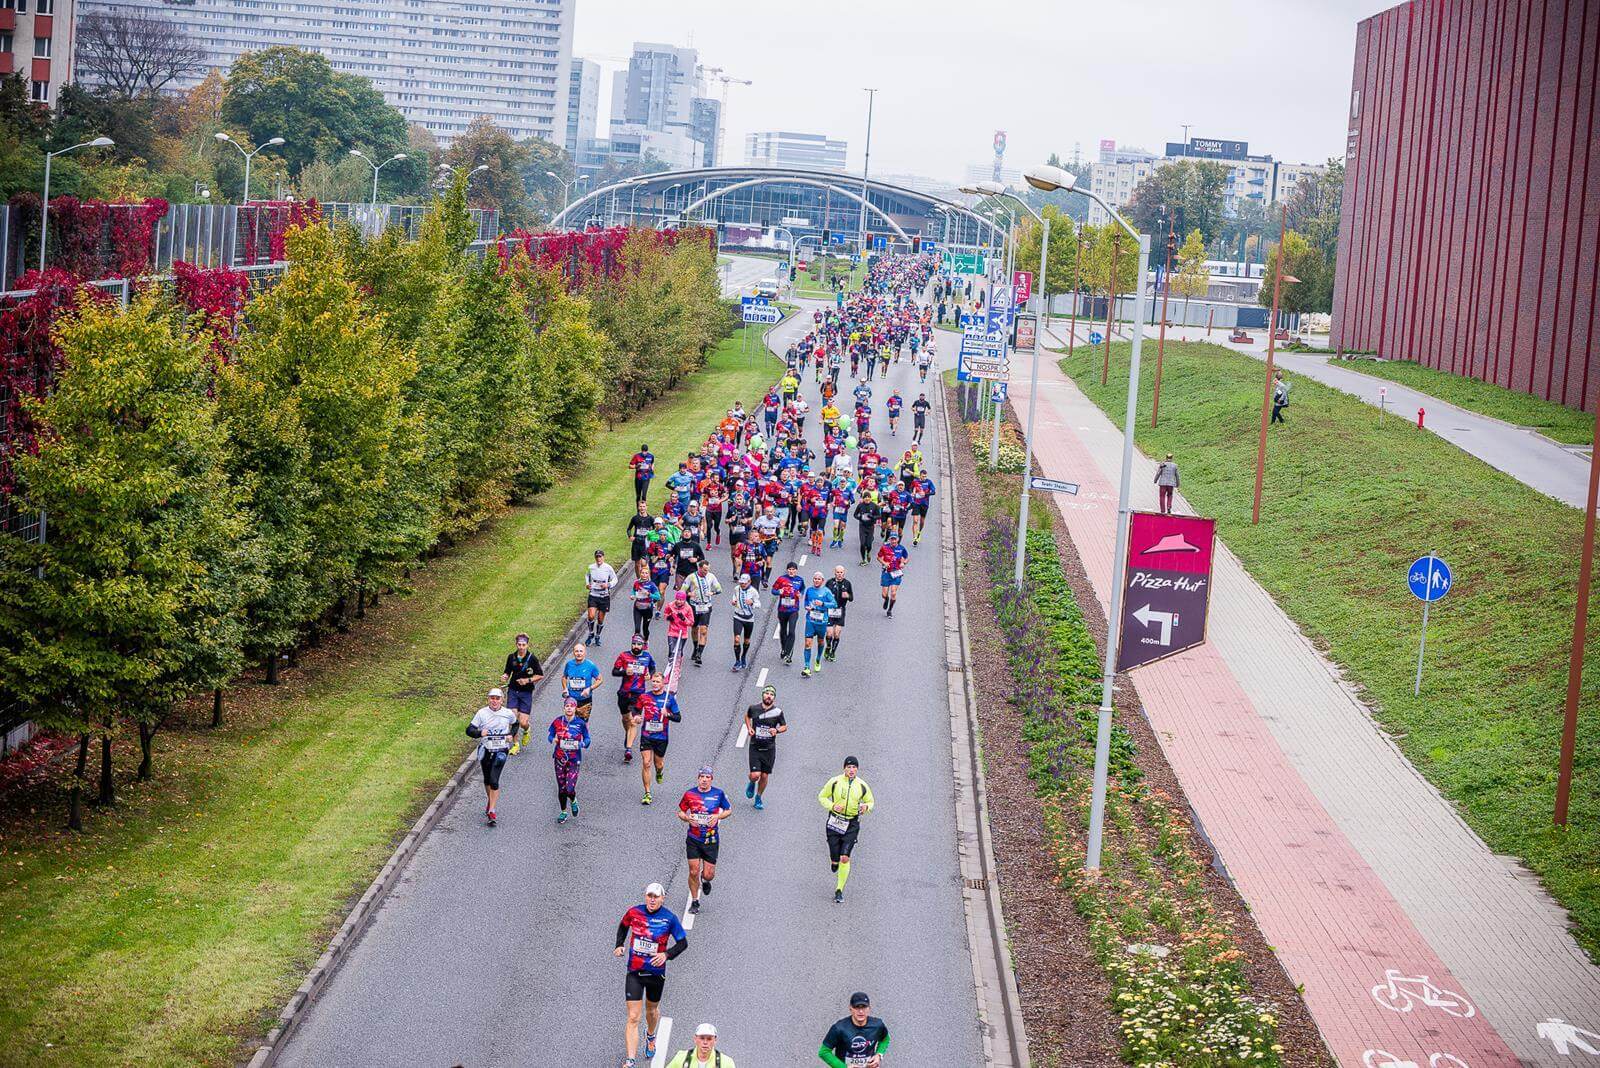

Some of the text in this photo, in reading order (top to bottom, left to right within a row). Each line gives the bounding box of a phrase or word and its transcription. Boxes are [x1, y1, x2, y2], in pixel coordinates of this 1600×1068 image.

[1195, 140, 1223, 148] TOMMY
[1130, 572, 1206, 592] Pizza Hut
[1140, 637, 1160, 645] 400m
